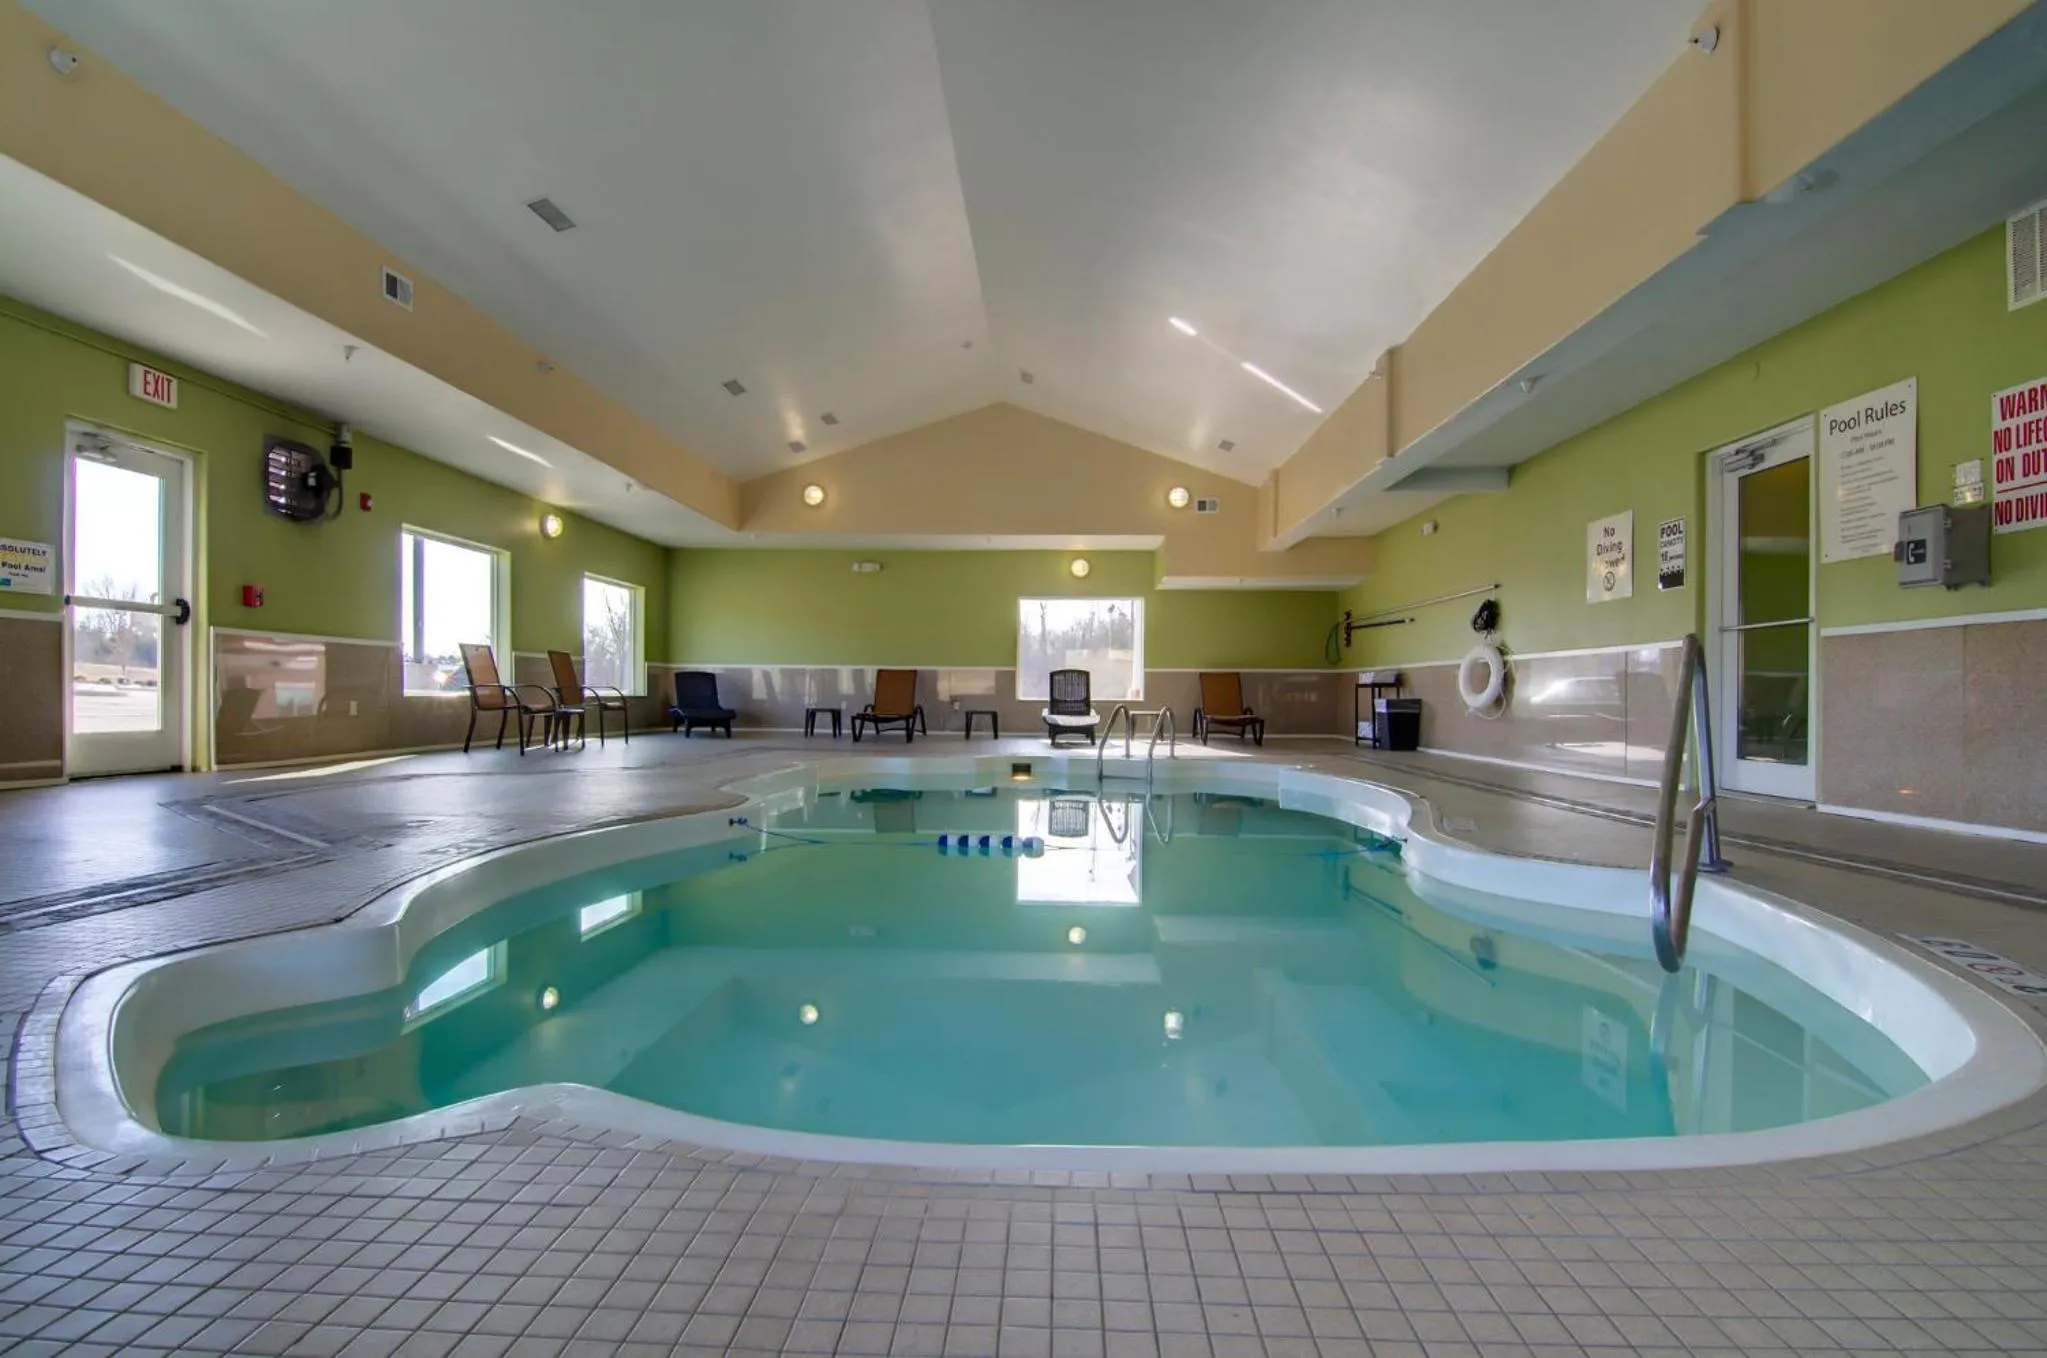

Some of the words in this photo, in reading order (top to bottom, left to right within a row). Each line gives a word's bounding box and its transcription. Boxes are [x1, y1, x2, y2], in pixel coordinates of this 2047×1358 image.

[144, 369, 173, 404] EXIT
[1829, 410, 1861, 436] Pool
[1865, 401, 1906, 424] Rules
[1994, 426, 2012, 455] NO
[1996, 456, 2015, 484] ON
[1995, 500, 2012, 526] NO
[2016, 492, 2047, 523] DIVI
[1660, 522, 1683, 539] POOL
[0, 543, 48, 557] SOLUTELY
